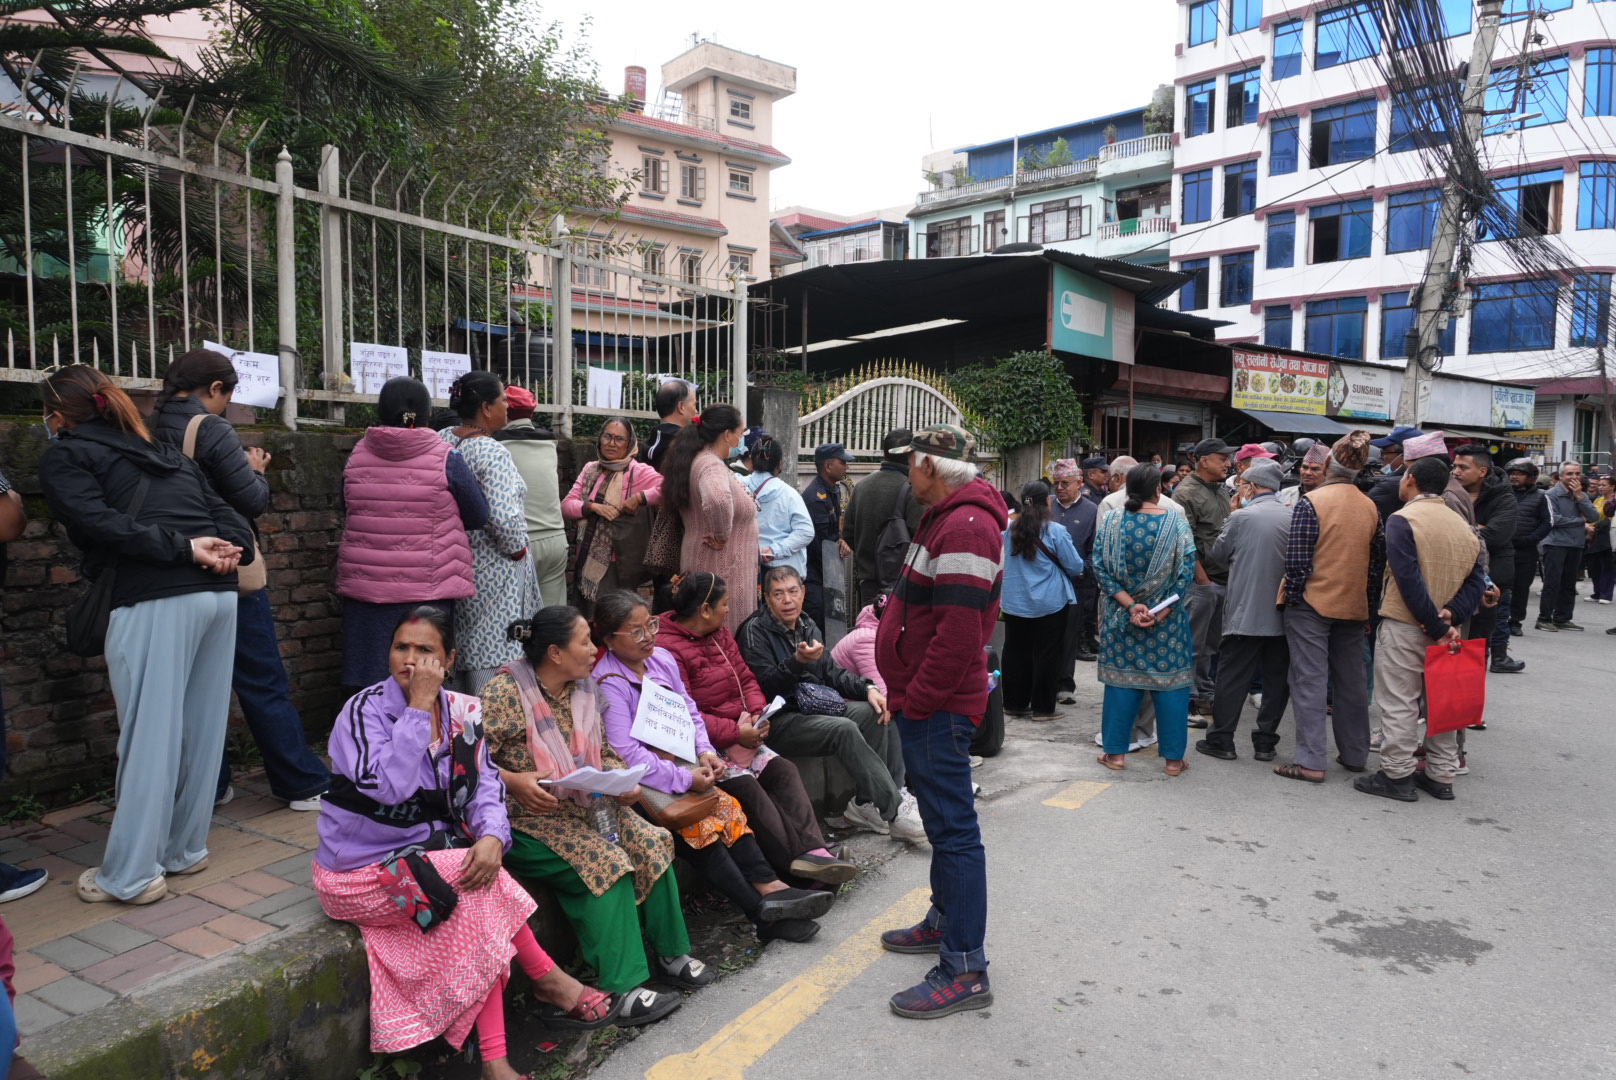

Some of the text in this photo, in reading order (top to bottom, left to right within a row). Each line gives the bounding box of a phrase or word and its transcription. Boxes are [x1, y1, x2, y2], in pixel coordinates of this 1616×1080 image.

[1289, 359, 1301, 371] तथा
[1302, 361, 1317, 374] खाजा
[1318, 363, 1327, 375] घर
[1352, 383, 1384, 397] SUNSHINE
